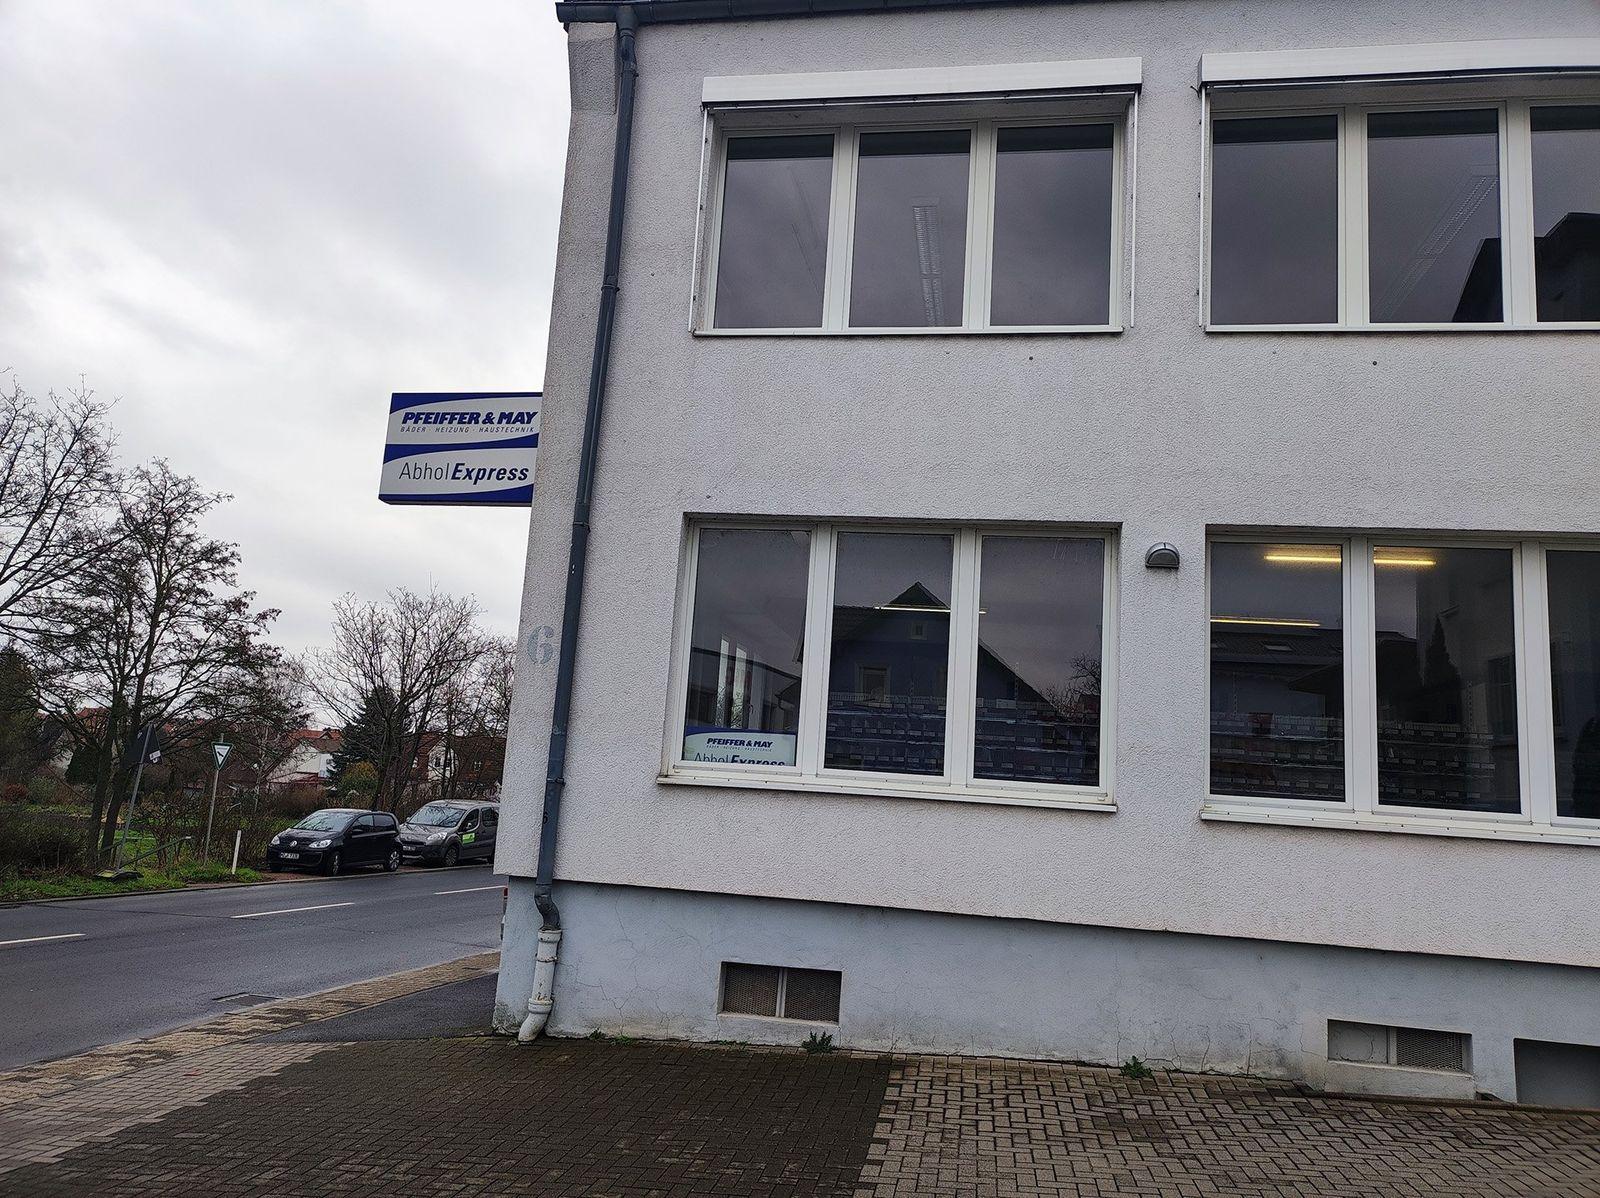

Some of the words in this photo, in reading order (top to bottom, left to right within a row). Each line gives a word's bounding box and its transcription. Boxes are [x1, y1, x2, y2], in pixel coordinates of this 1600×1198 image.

[401, 411, 481, 425] PFEIFFER
[482, 411, 496, 425] &
[497, 411, 538, 425] MAY
[528, 625, 554, 664] 6
[706, 737, 745, 747] PFEIFFER
[746, 739, 753, 747] &
[753, 740, 773, 748] MAY
